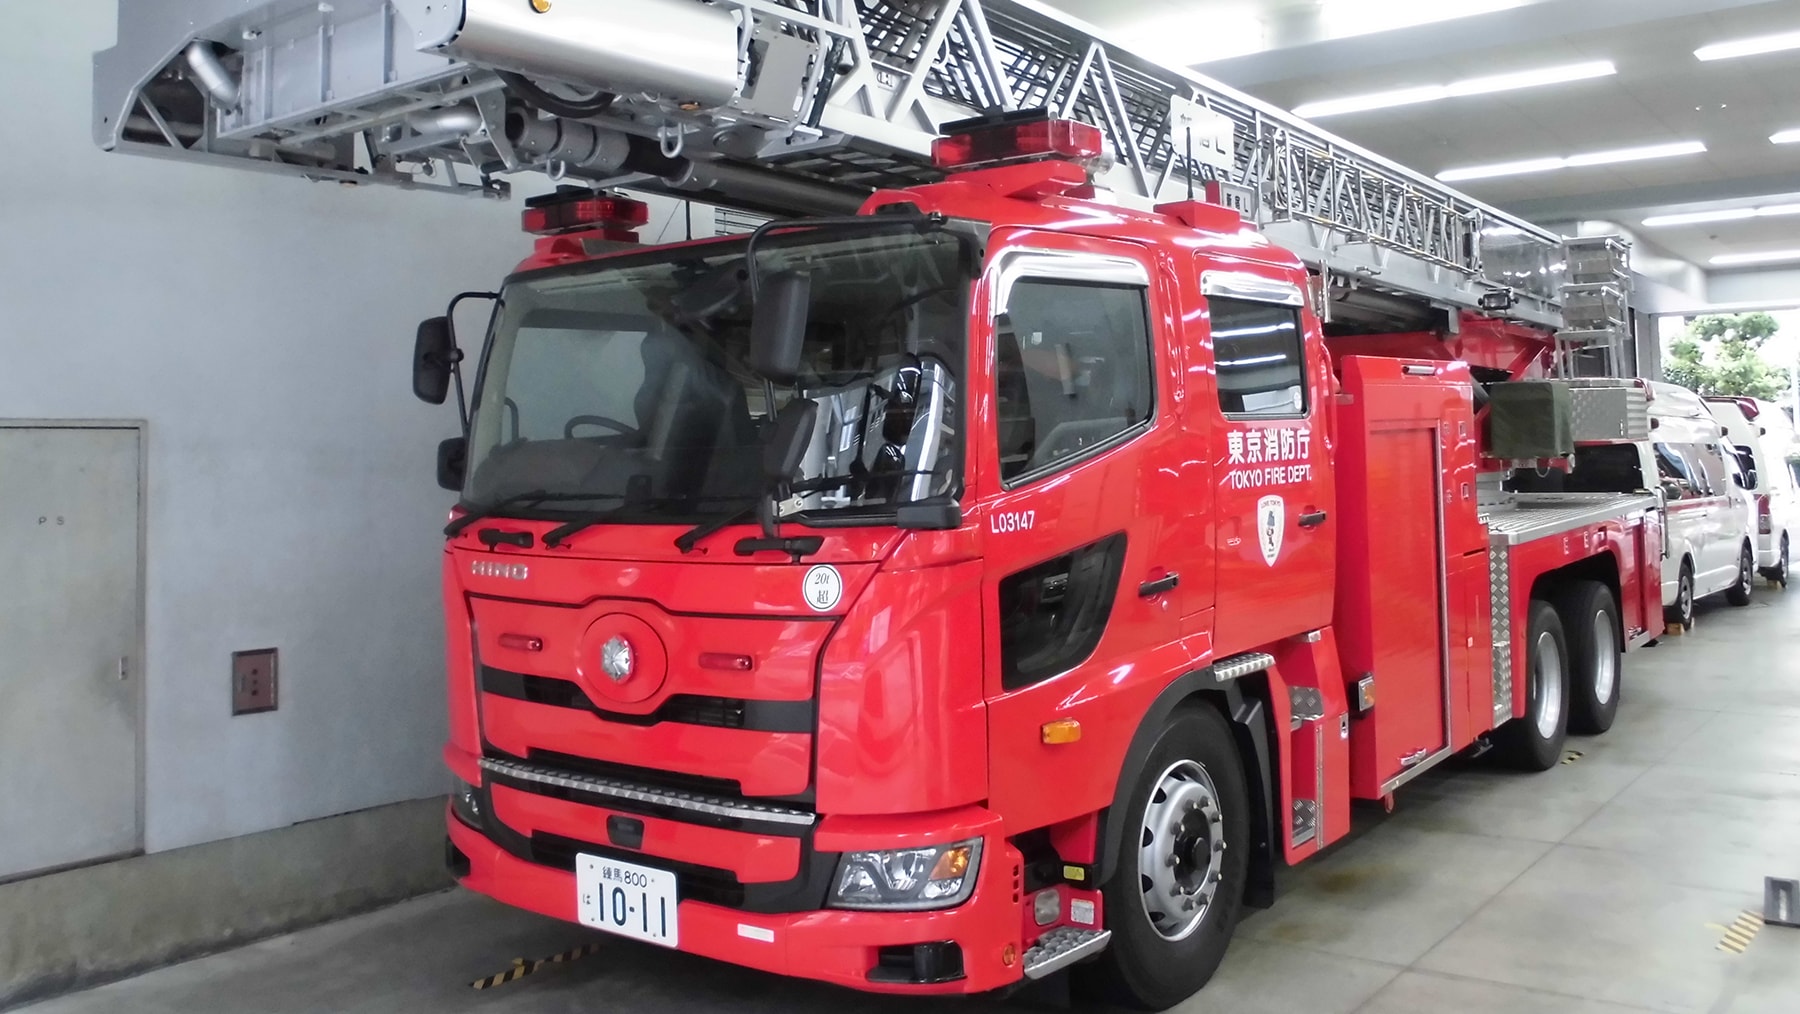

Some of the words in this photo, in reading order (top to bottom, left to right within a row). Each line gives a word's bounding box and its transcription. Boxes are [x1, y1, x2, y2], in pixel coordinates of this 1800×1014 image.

[1226, 427, 1311, 465] 東京消防庁
[1229, 468, 1263, 490] TOKYO
[1264, 466, 1287, 486] FIRE
[1287, 464, 1313, 483] DEPT.
[990, 510, 1035, 534] L03147
[472, 560, 529, 581] HINO
